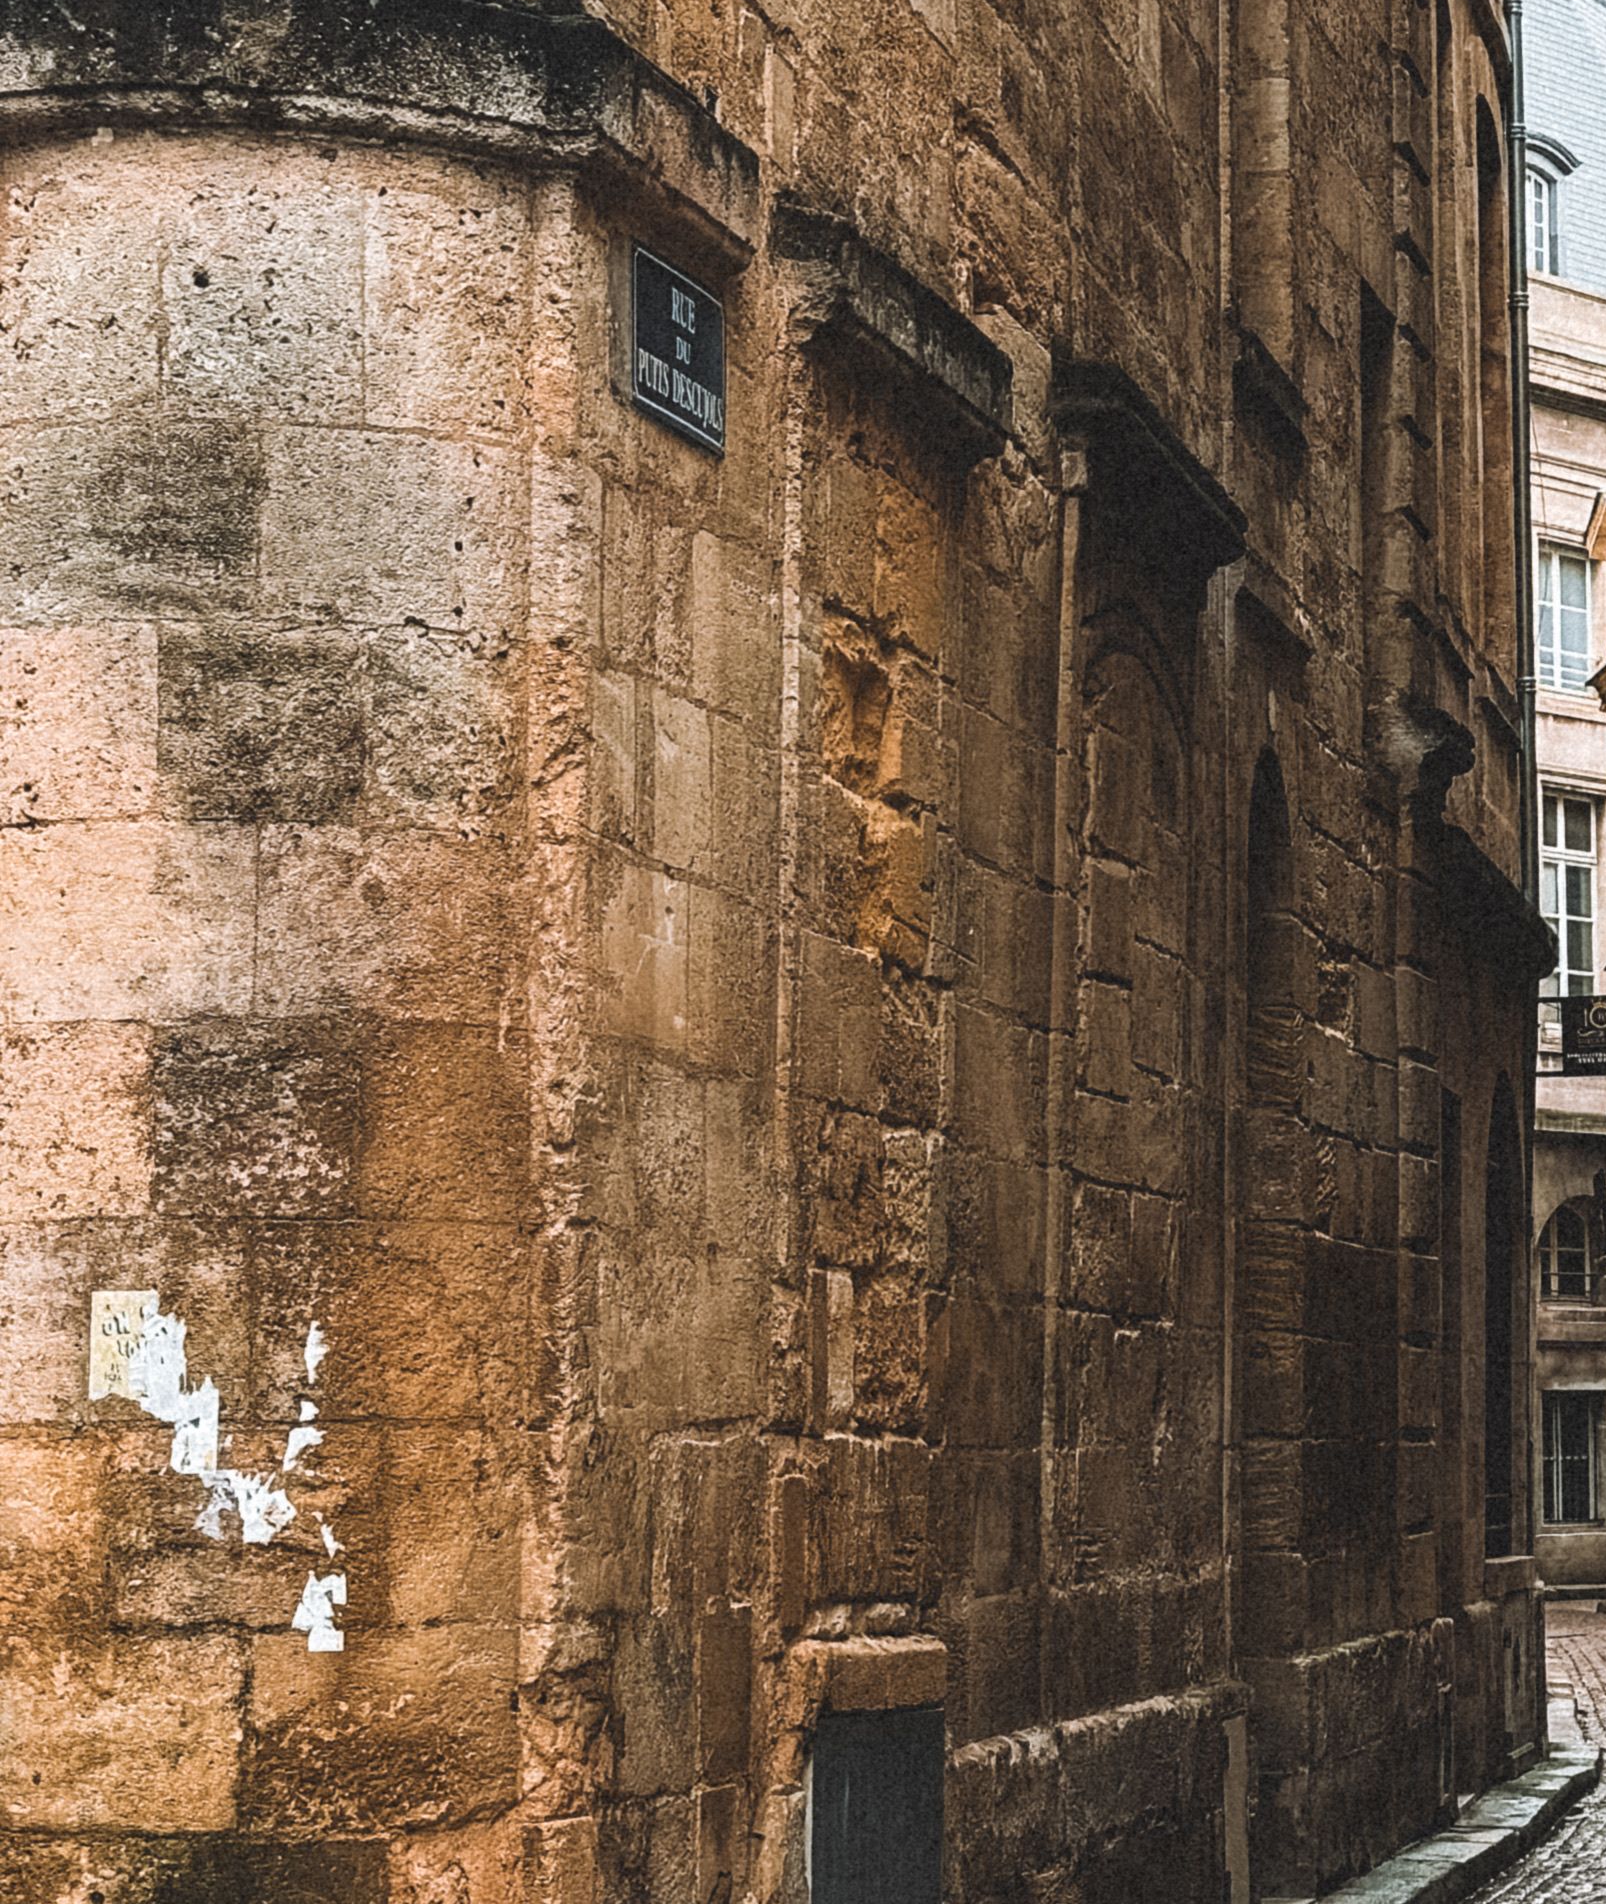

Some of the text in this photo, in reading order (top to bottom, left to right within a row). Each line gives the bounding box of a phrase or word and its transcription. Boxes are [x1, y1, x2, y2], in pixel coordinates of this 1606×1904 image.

[671, 286, 696, 335] RUE
[675, 336, 692, 365] DU
[638, 347, 724, 432] PUITS DESCUJOLS
